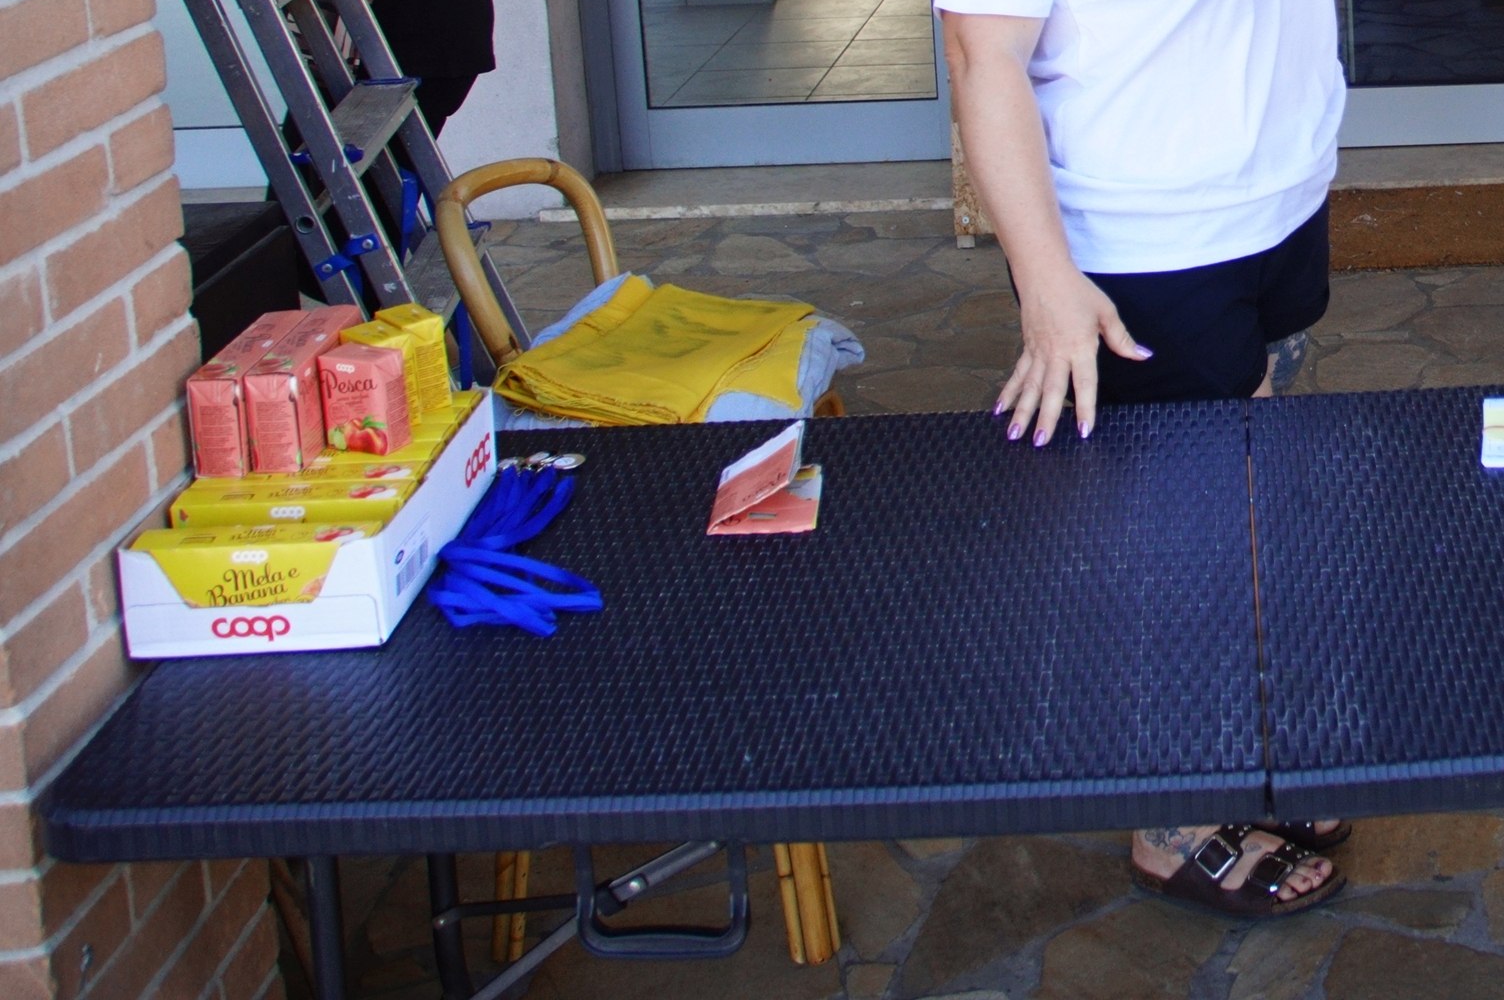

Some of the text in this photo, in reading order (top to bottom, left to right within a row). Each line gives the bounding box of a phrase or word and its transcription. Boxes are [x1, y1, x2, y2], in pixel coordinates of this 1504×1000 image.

[318, 366, 377, 400] Pesca
[463, 431, 491, 489] coop
[220, 560, 301, 593] Mela e
[206, 582, 289, 609] Banana
[211, 614, 291, 642] coop
